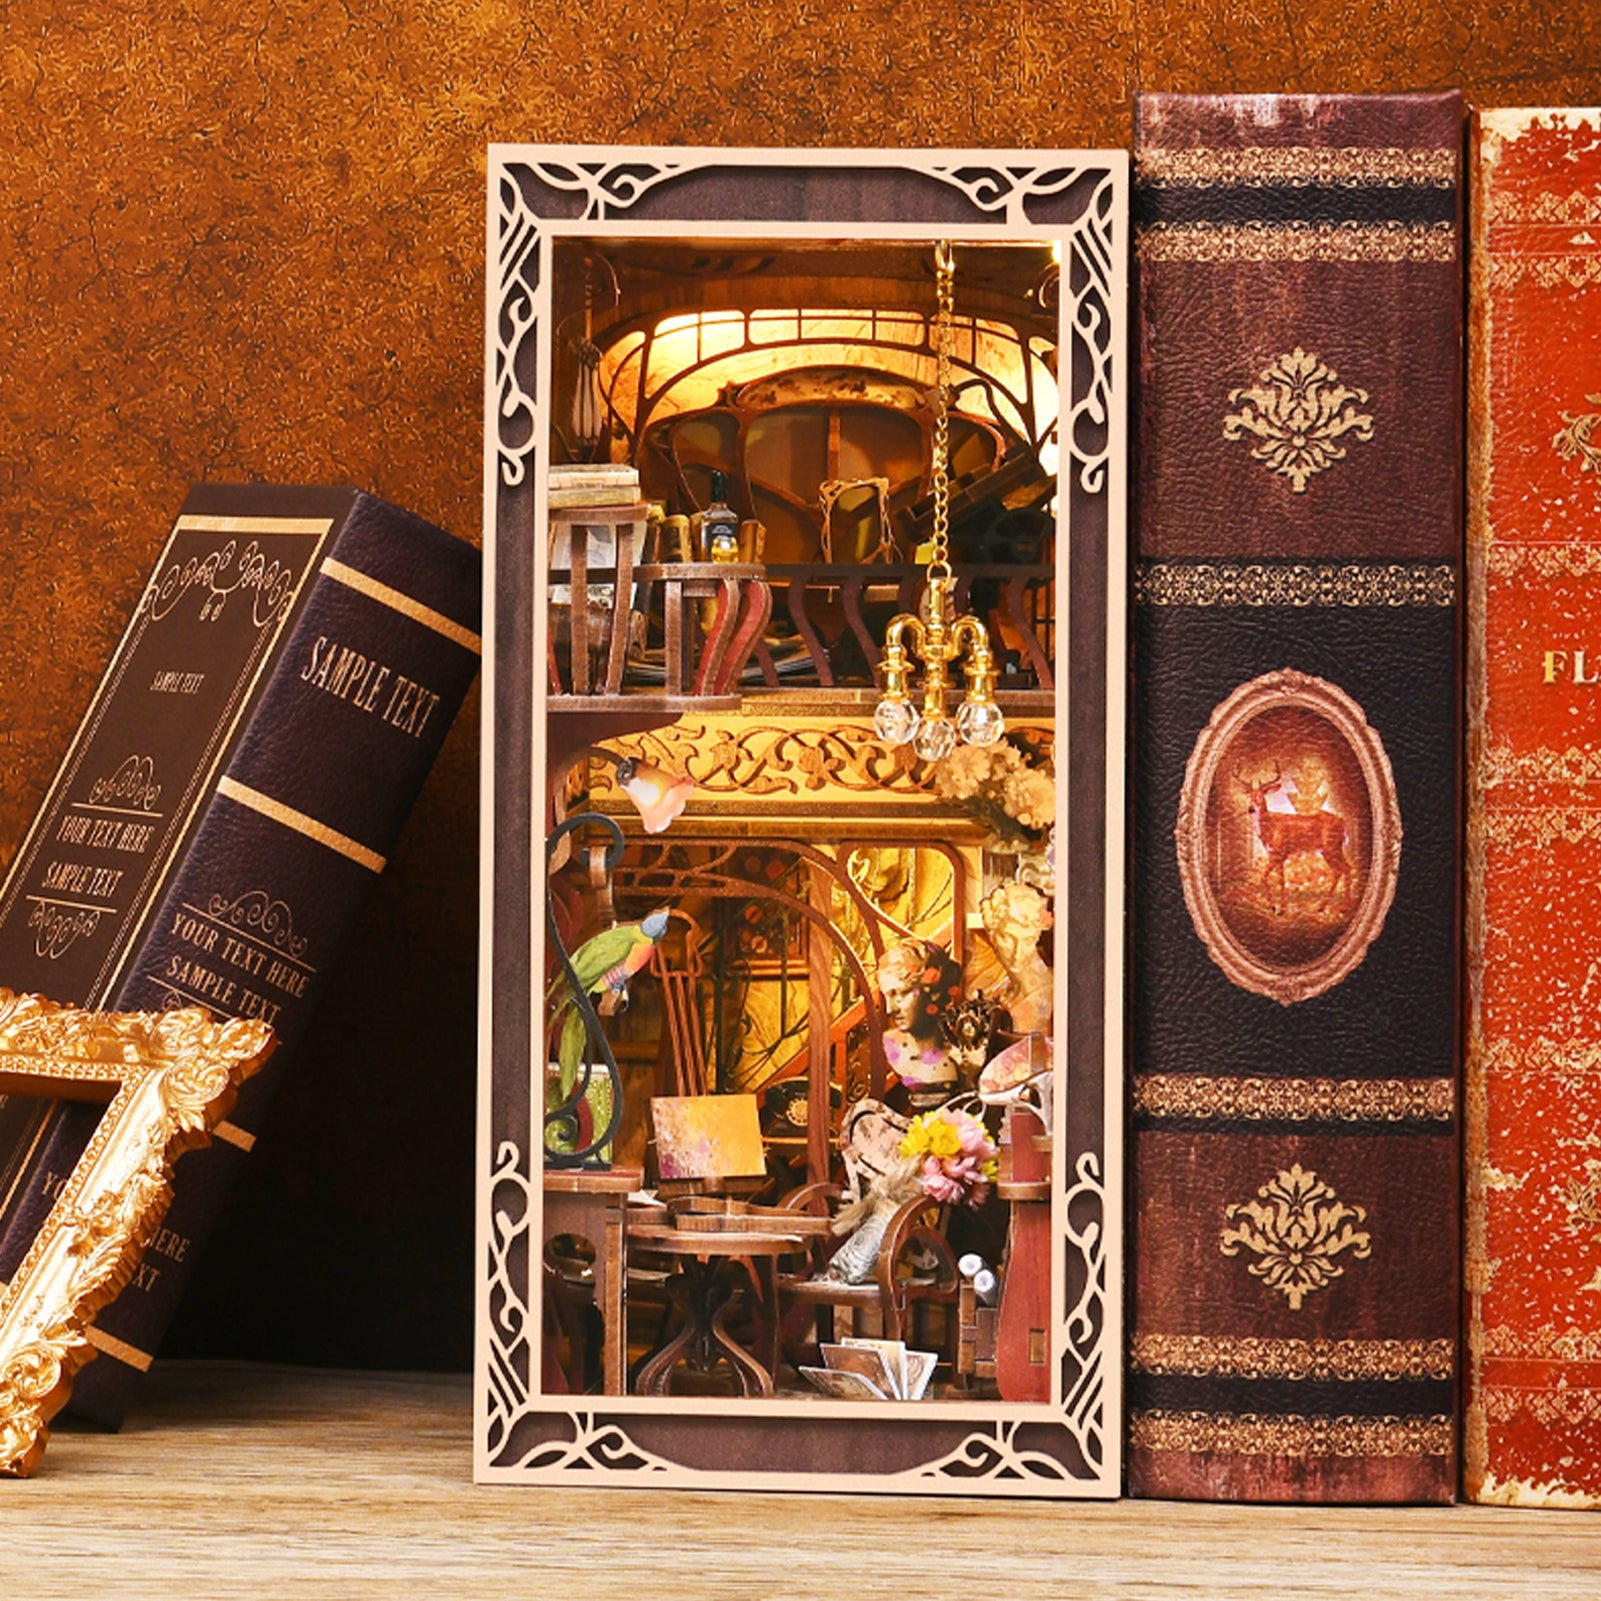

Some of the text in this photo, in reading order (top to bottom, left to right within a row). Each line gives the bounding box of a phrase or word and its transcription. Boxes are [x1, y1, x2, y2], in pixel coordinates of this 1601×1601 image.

[300, 635, 440, 738] SAMPLE TEXT
[56, 815, 155, 853] YOUR TEXT HERE
[41, 861, 123, 898] SAMPLE TEXT
[166, 955, 281, 1025] SAMPLE TEXT
[171, 912, 310, 998] YOUR TEXT HERE
